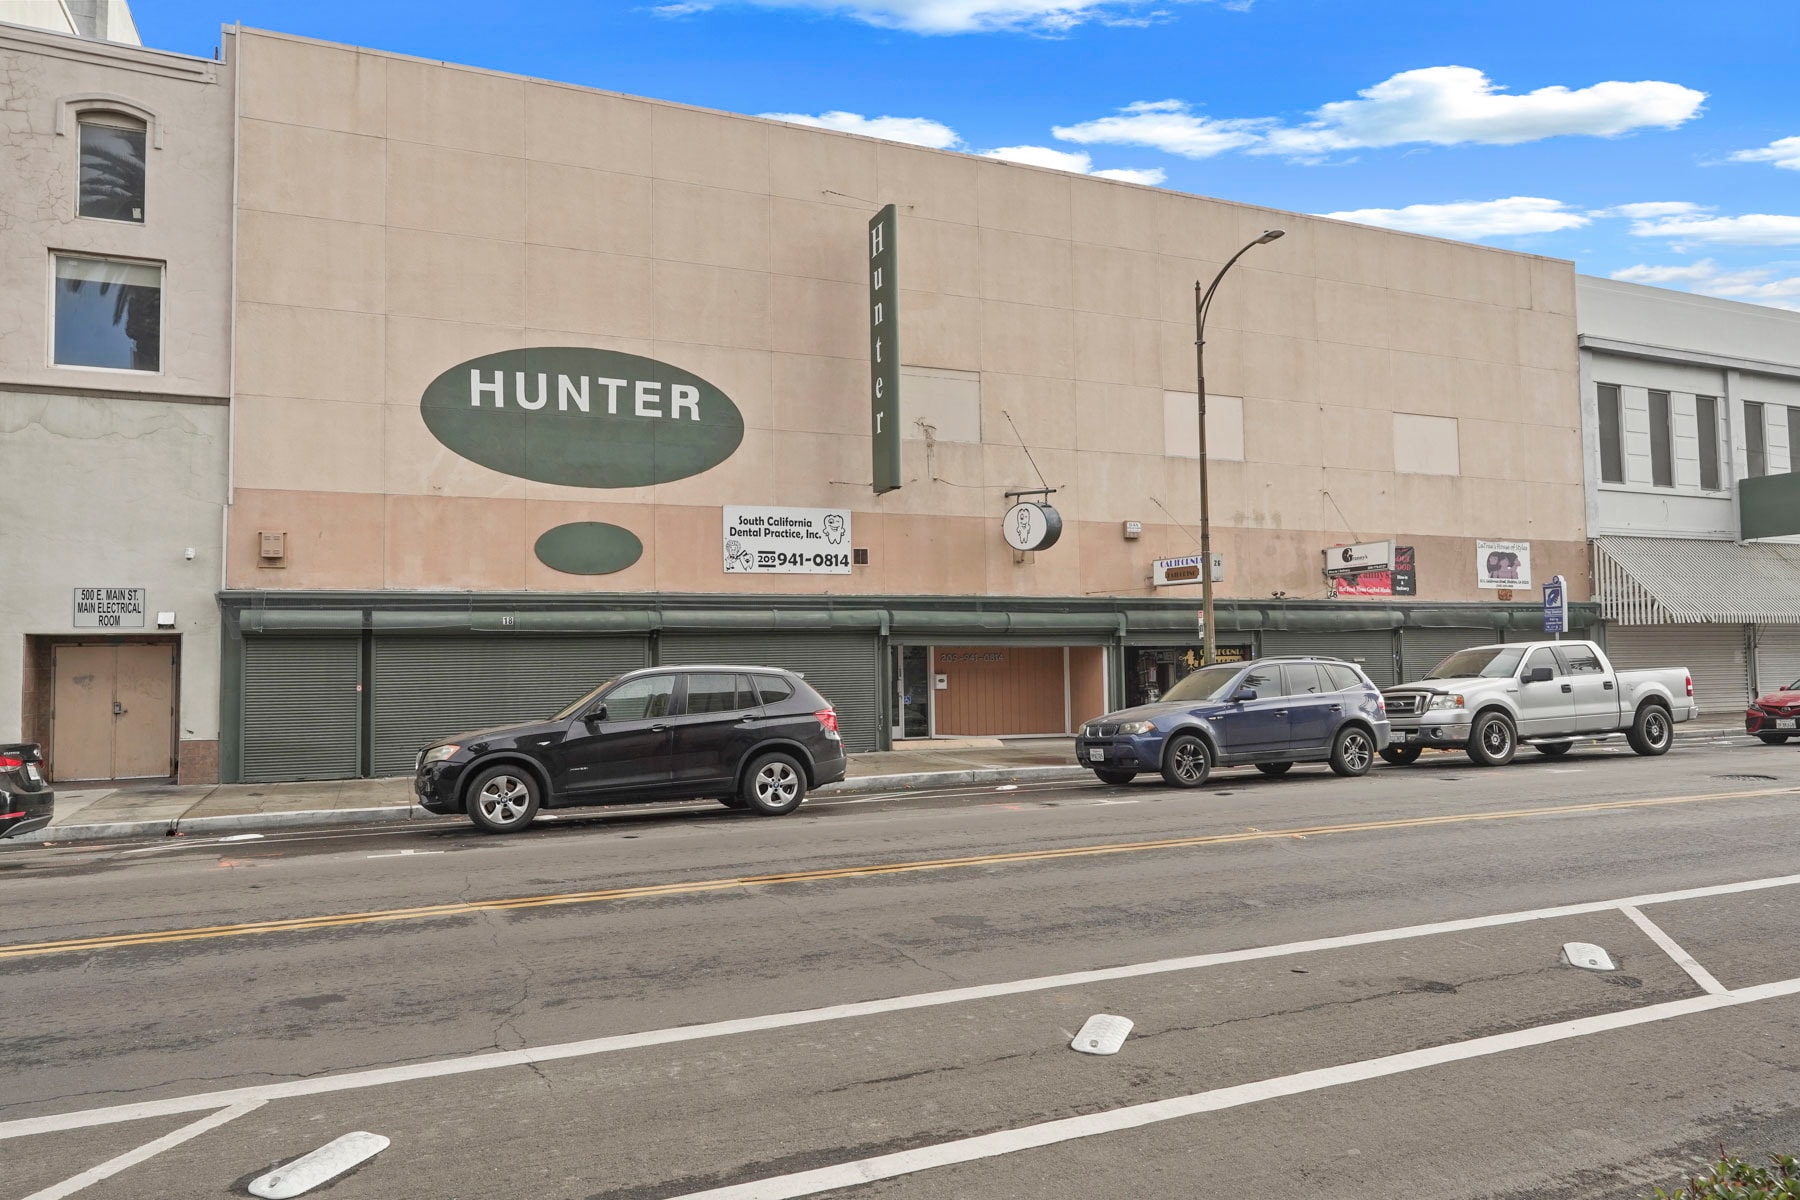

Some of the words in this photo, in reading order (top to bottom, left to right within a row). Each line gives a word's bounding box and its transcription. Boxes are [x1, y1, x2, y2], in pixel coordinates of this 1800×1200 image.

[871, 221, 884, 434] Hunter
[470, 368, 701, 421] HUNTER
[738, 515, 764, 526] South
[767, 516, 812, 528] California
[729, 526, 761, 537] Dental
[764, 528, 804, 540] Practice,
[806, 529, 822, 539] Inc.
[757, 555, 776, 563] 209
[777, 552, 850, 567] 941-0814
[81, 589, 95, 601] 500
[96, 589, 104, 601] E.
[105, 589, 126, 601] MAIN
[127, 590, 139, 601] ST.
[77, 602, 95, 613] MAIN
[97, 602, 141, 614] ELECTRICAL
[98, 614, 120, 626] ROOM
